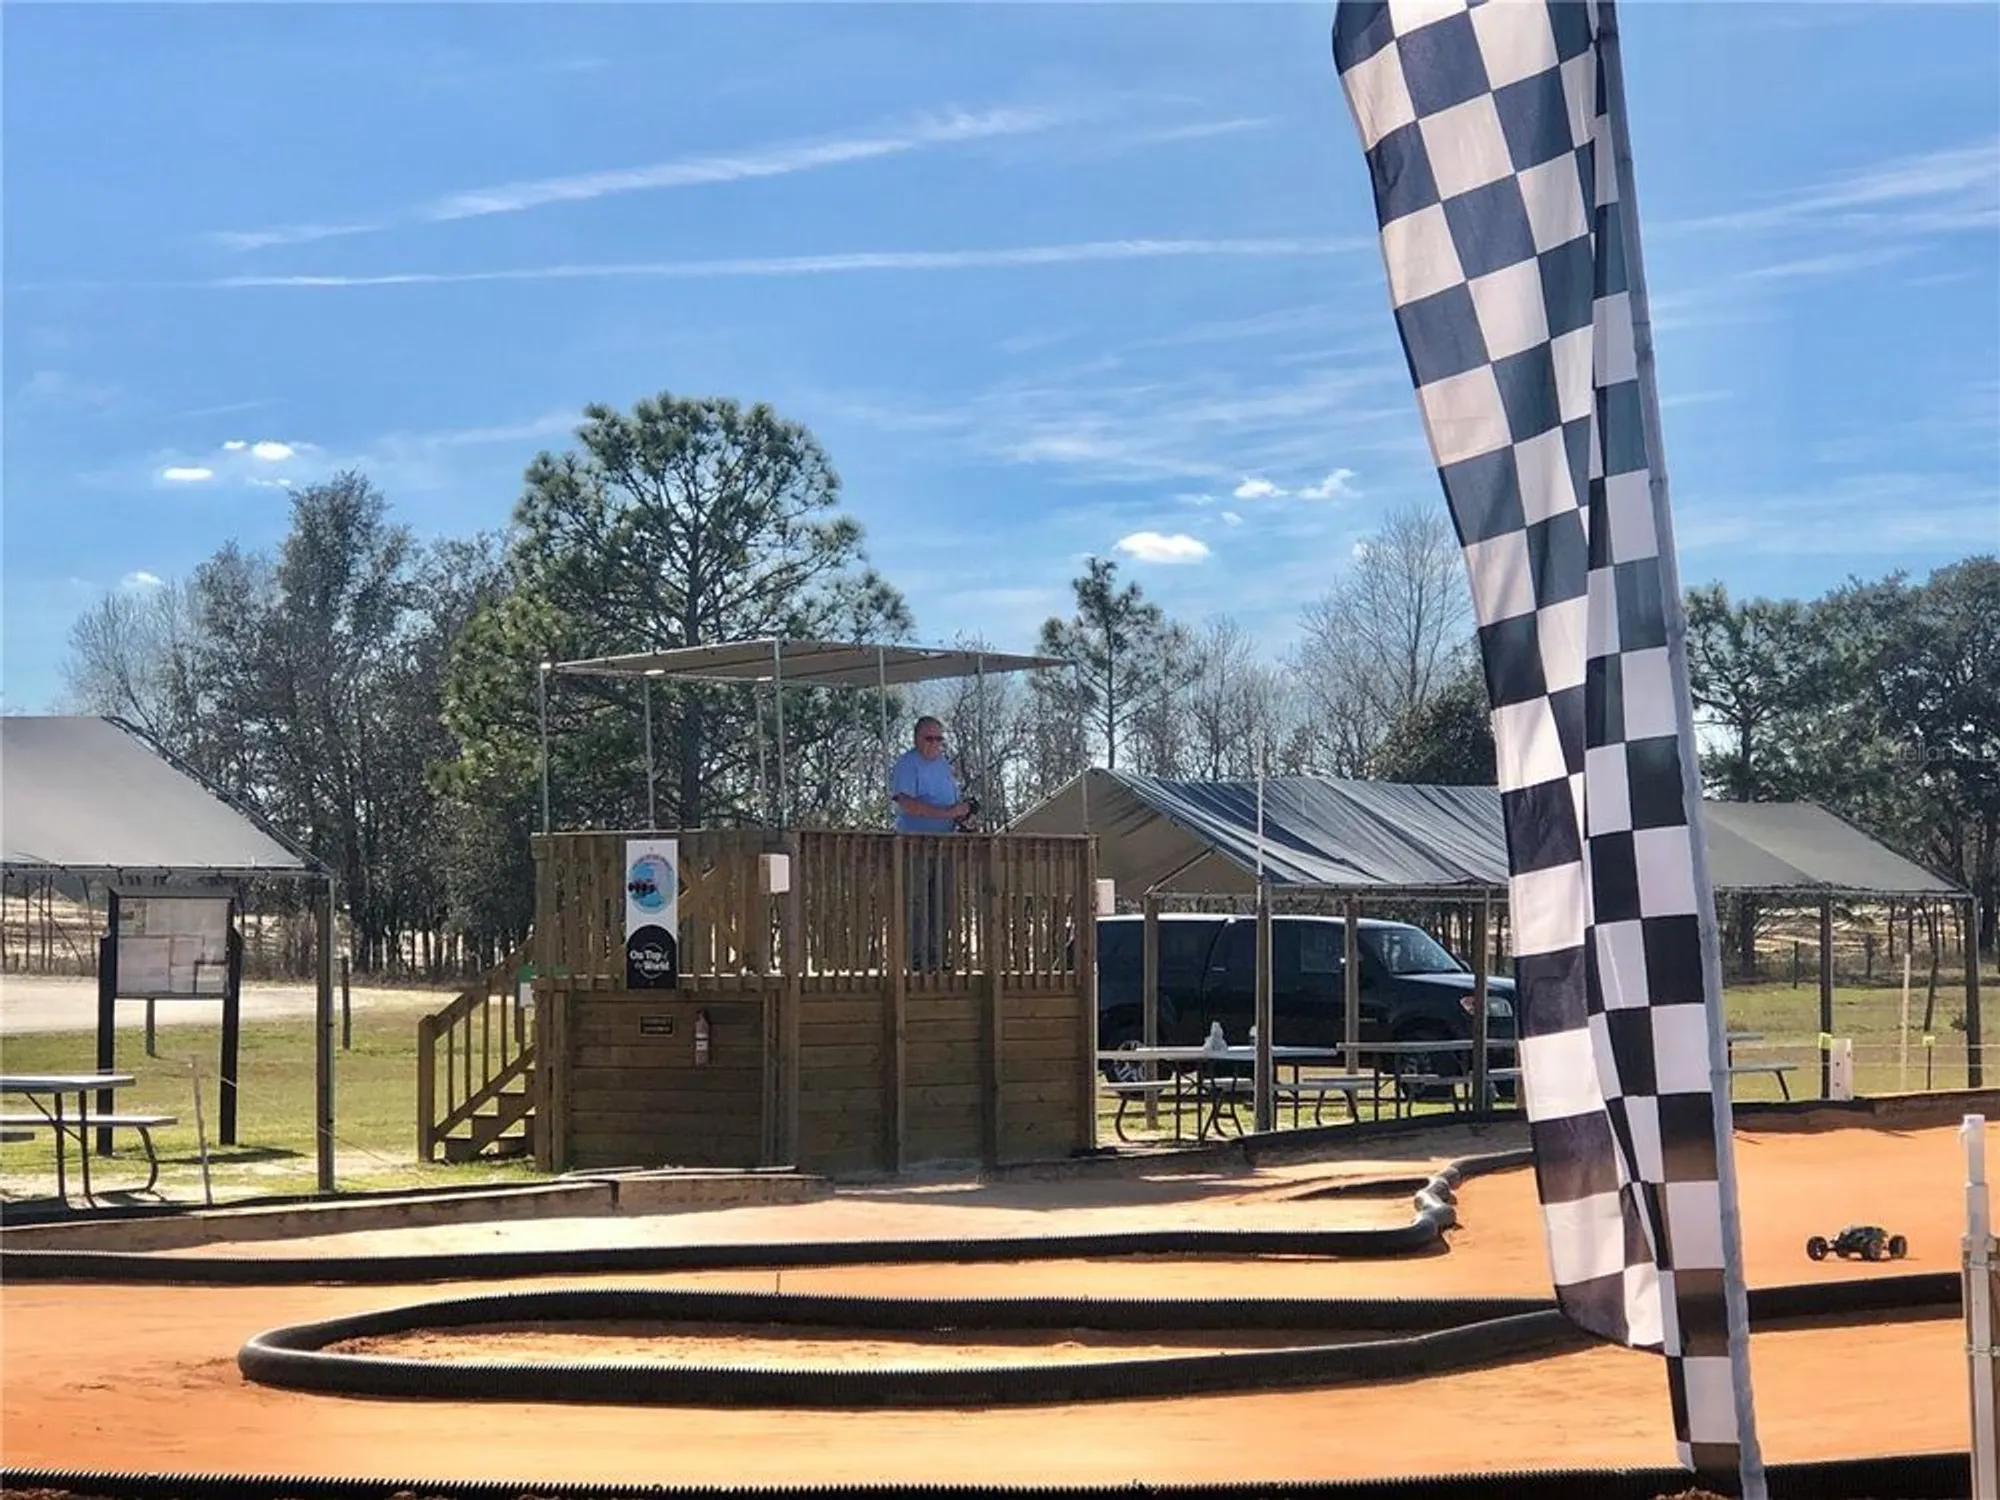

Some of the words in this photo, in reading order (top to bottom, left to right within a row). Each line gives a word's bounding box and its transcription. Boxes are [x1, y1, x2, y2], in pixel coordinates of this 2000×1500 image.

[629, 949, 643, 960] On
[644, 950, 661, 962] Top
[643, 960, 670, 970] World
